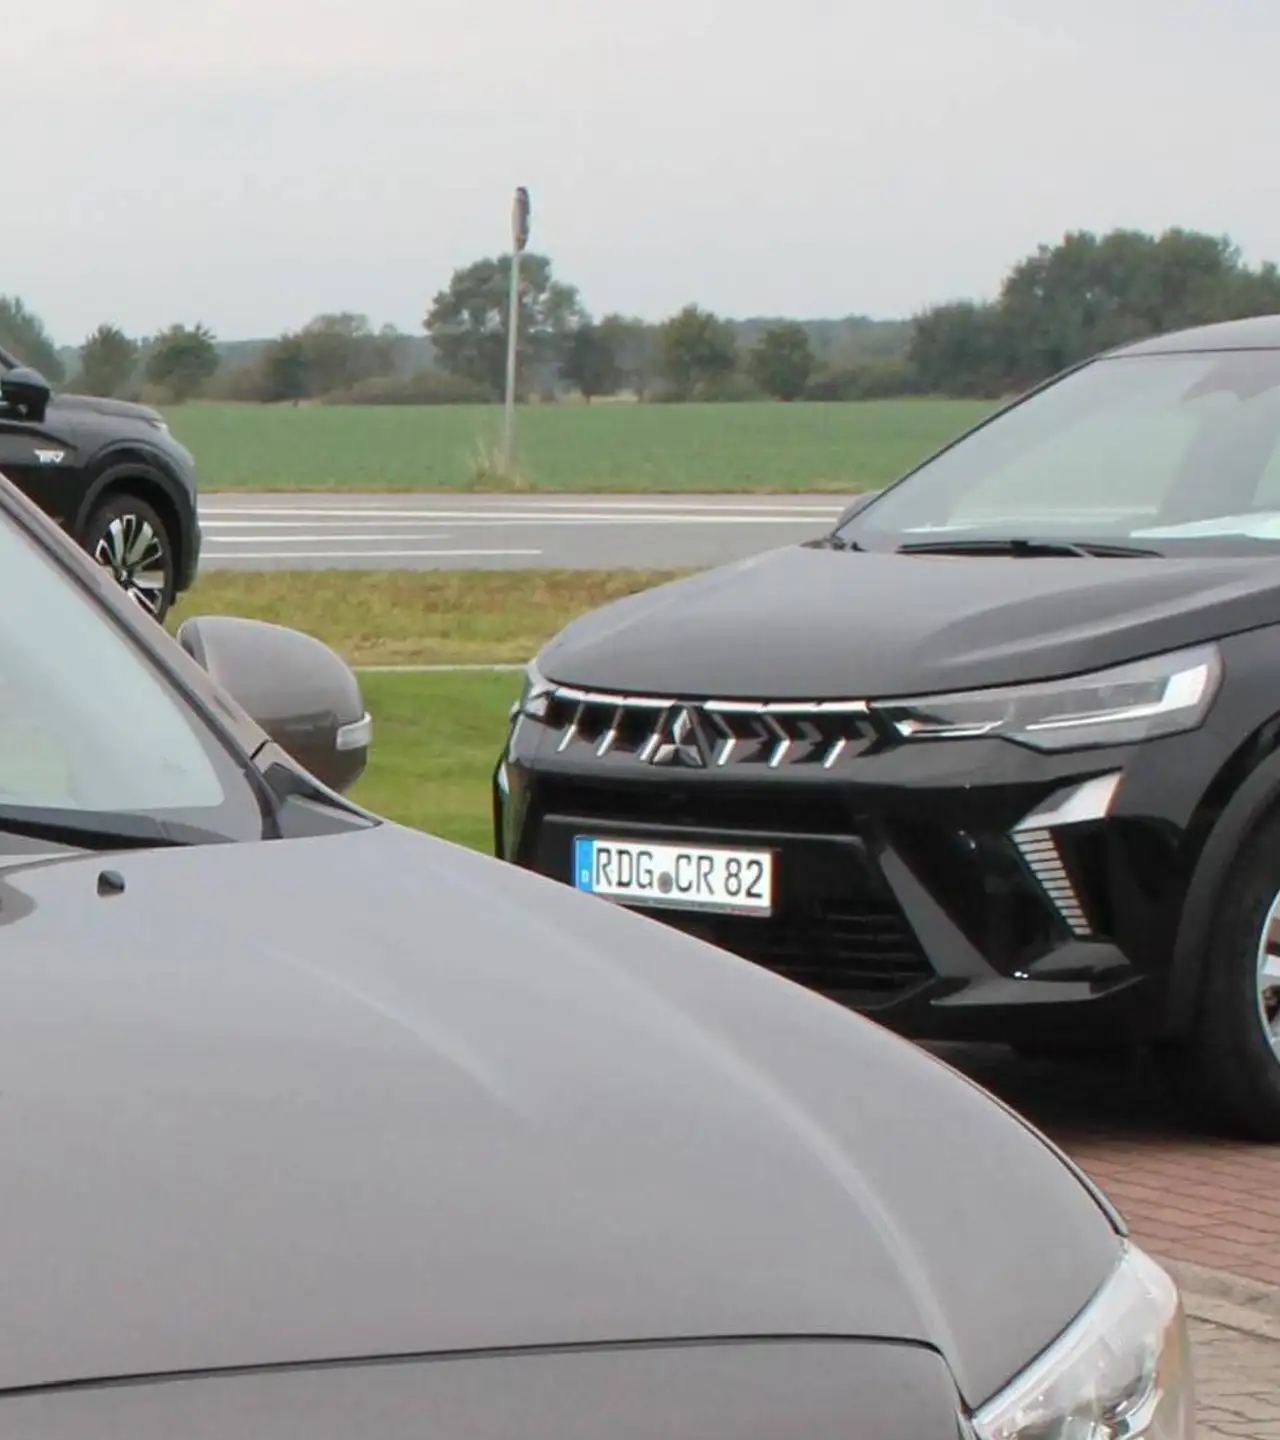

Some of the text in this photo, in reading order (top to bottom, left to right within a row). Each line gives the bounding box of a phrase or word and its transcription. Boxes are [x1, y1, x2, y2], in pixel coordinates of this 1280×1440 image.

[595, 847, 764, 898] RDG CR 82
